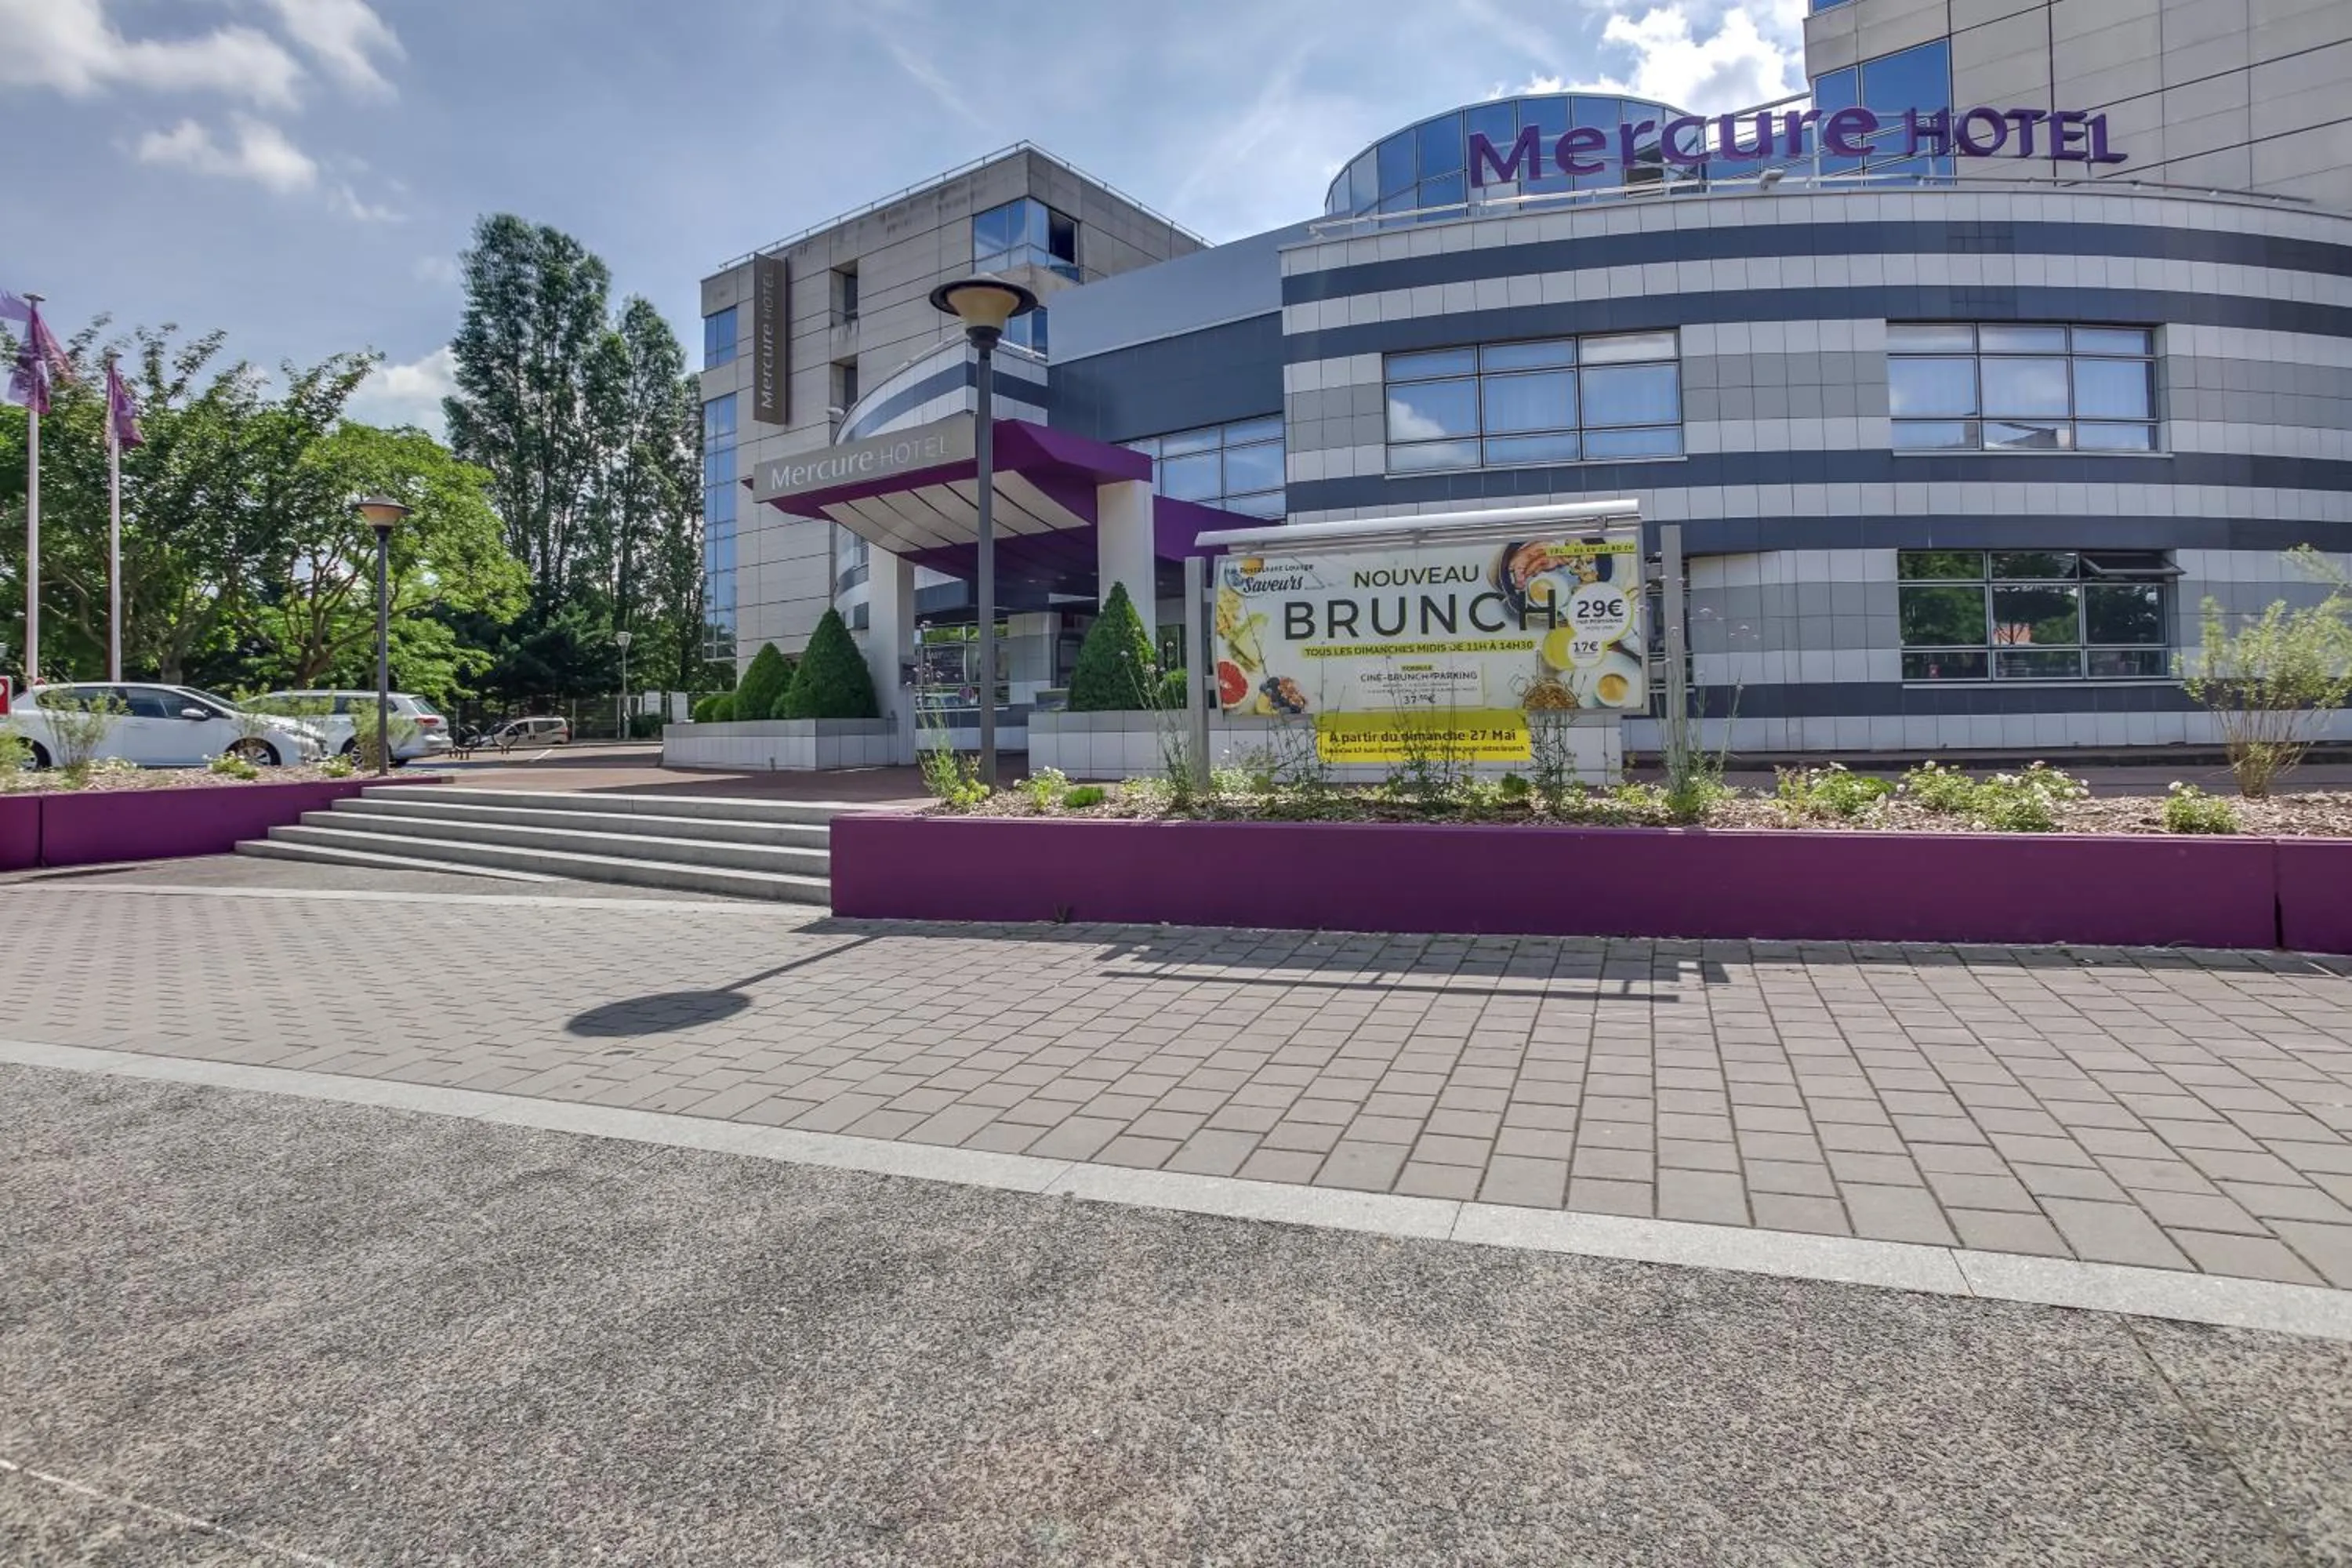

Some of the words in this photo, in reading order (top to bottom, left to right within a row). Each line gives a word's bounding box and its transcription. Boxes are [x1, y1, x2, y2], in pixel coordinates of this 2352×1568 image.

[1468, 107, 1878, 188] Mercure
[1905, 105, 2128, 163] HOTEL
[763, 271, 774, 319] HOTEL
[761, 324, 774, 408] Mercure
[771, 450, 873, 489] Mercure
[879, 436, 949, 466] HOTEL
[1354, 564, 1479, 588] NOUVEAU
[1285, 589, 1555, 641] BRUNCH
[1577, 598, 1624, 618] 29€
[1305, 647, 1331, 656] TOUS
[1334, 646, 1354, 656] LES
[1355, 644, 1413, 655] DIMANCHES
[1417, 644, 1446, 653] MIDIS
[1341, 730, 1377, 745] partir
[1381, 731, 1398, 742] du
[1402, 730, 1465, 741] dimanche
[1470, 730, 1486, 741] 27
[1493, 729, 1516, 741] Mai
